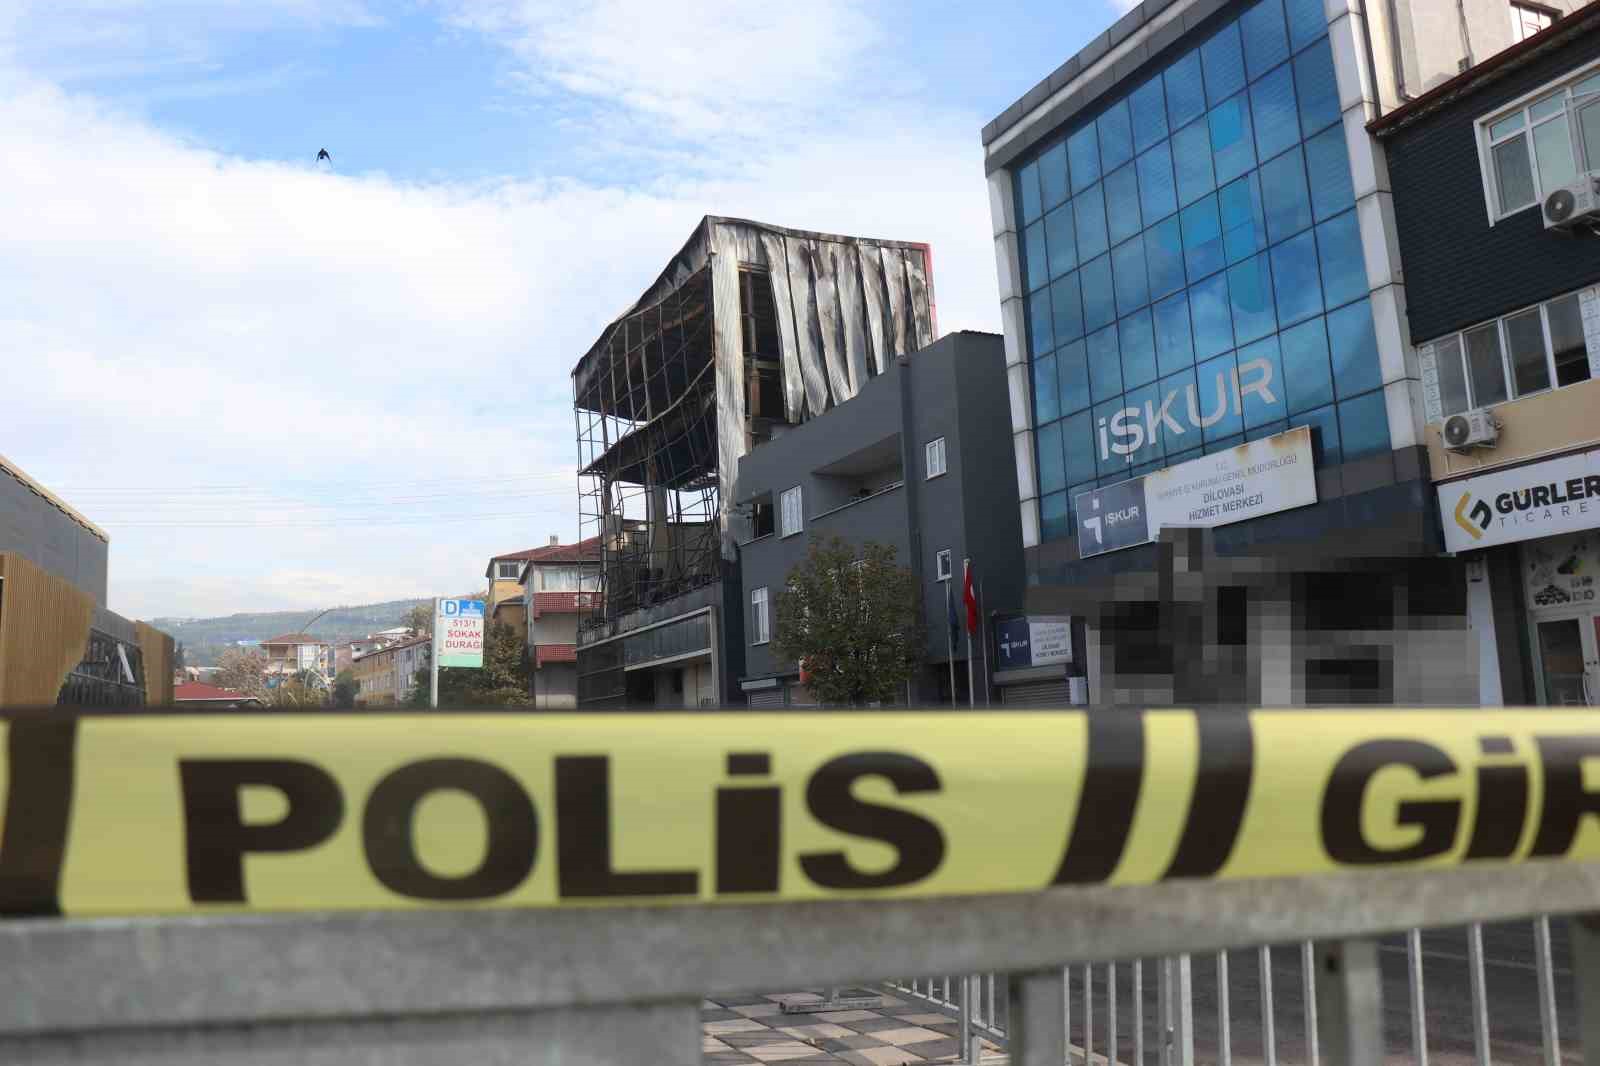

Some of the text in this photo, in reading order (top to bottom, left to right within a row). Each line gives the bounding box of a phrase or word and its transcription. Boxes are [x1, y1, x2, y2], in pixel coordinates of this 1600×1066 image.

[1203, 484, 1245, 504] DİLOVASI
[1496, 475, 1600, 514] GÜRLER
[445, 601, 457, 615] D
[447, 630, 480, 638] SOKAK
